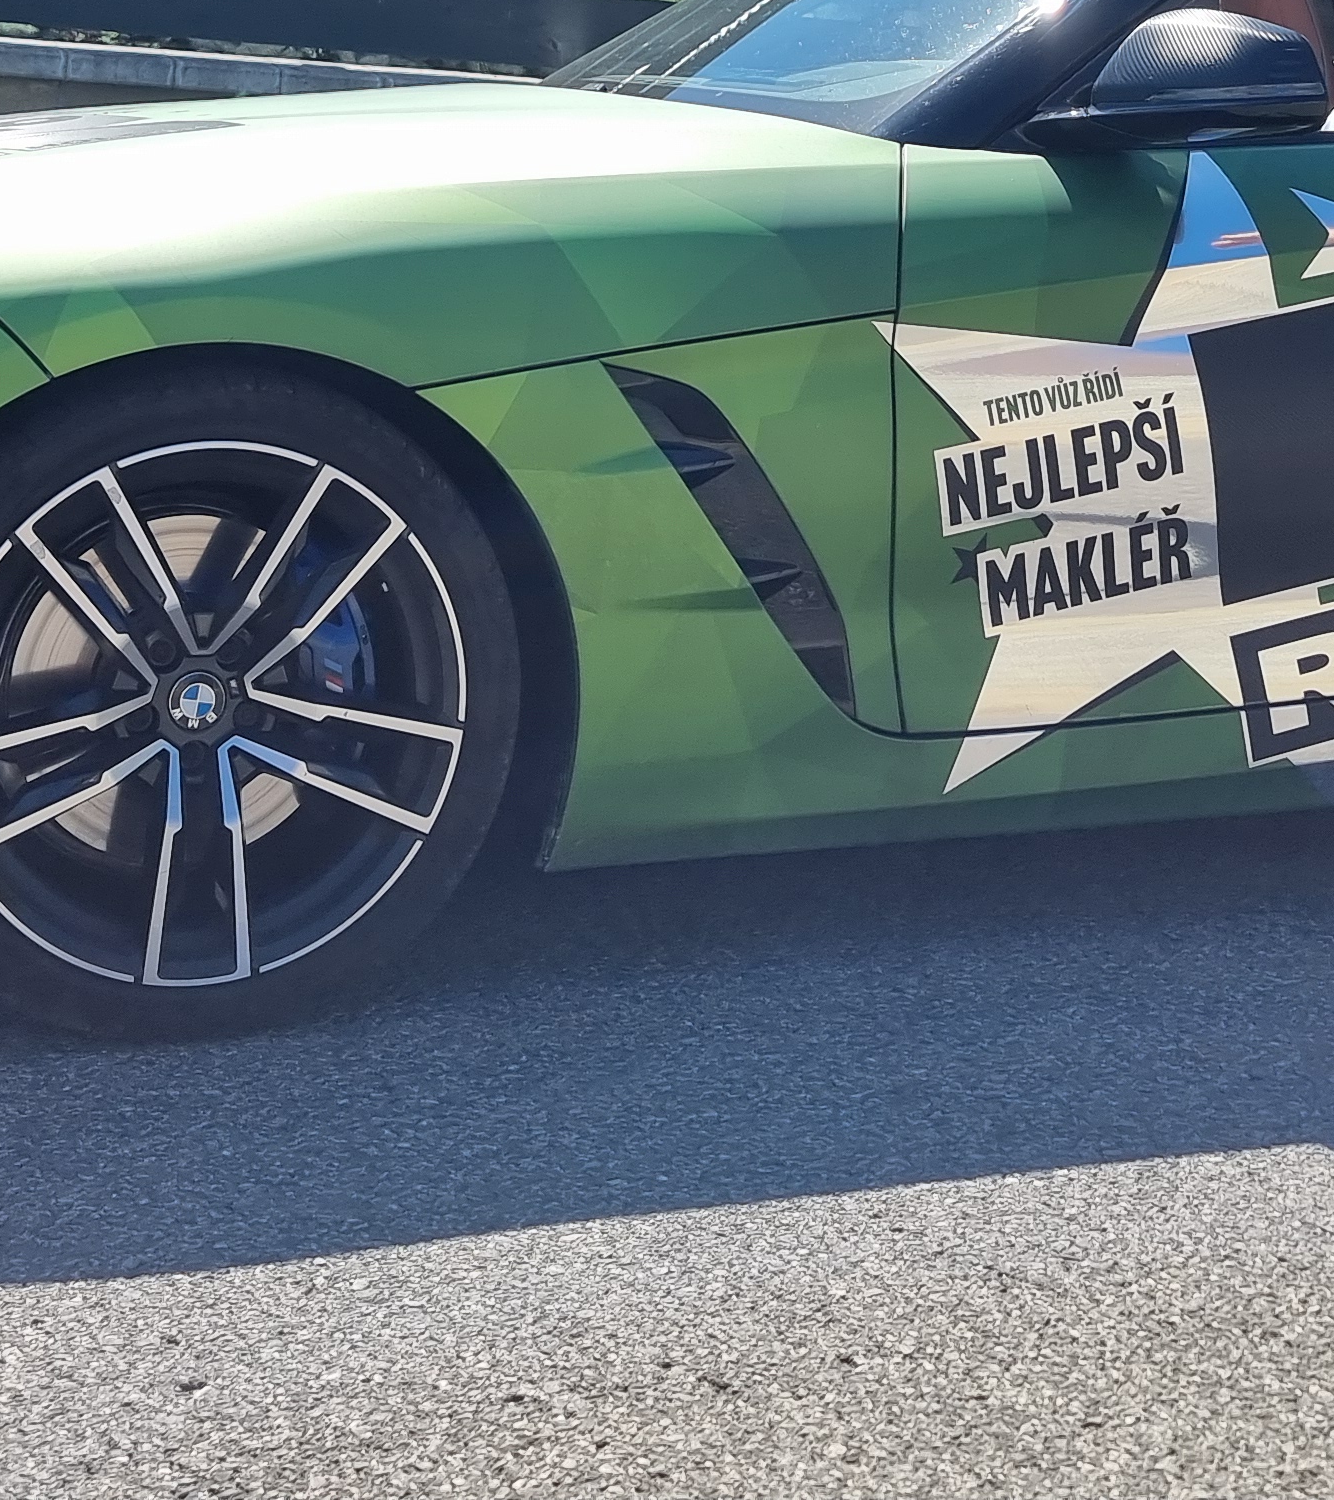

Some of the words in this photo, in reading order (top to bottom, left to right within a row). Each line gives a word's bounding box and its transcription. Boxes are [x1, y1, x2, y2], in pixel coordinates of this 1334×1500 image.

[941, 391, 1185, 527] NEJLEPŠÍ
[982, 388, 1044, 427] TENTO
[1043, 376, 1083, 412] VŮZ
[1082, 366, 1124, 407] ŘÍDÍ
[983, 502, 1193, 628] MAKLÉŘ
